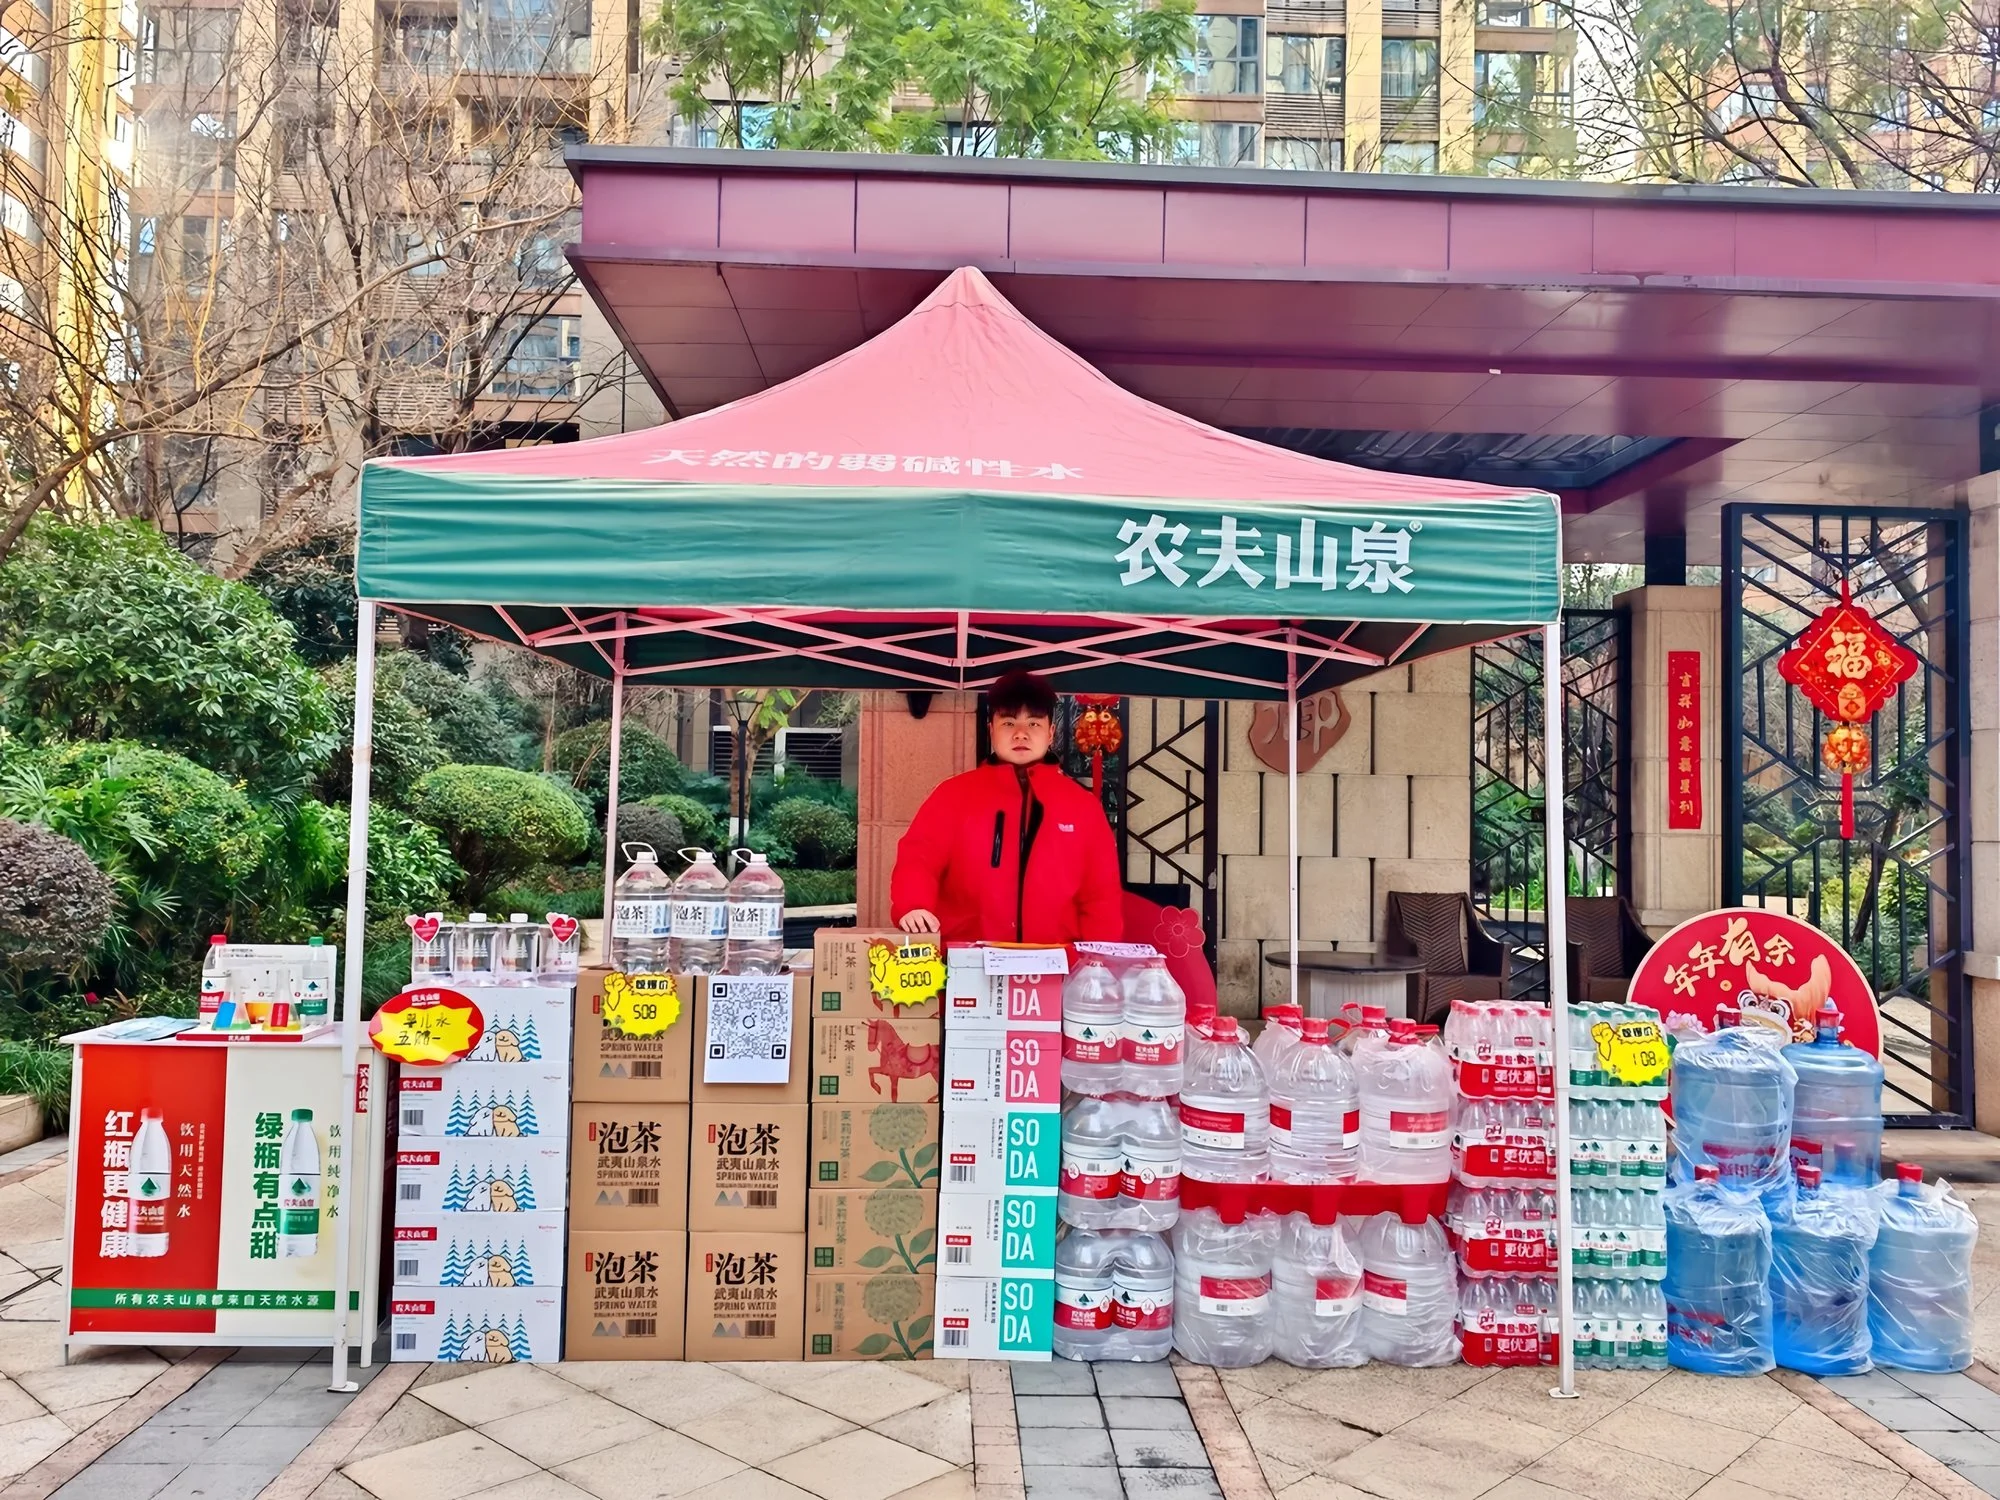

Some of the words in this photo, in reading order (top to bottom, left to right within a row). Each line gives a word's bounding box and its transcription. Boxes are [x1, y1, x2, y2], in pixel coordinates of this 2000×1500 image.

[641, 449, 1085, 480] 天然的弱碱性水
[1113, 513, 1416, 594] 农夫山泉
[1825, 631, 1872, 679] 福
[1663, 917, 1796, 997] 年年有余
[1012, 988, 1041, 1016] DA
[600, 1043, 631, 1052] SPRING
[634, 1043, 663, 1052] WATER
[1010, 1038, 1040, 1066] SO
[1010, 1069, 1040, 1098] DA
[1494, 1069, 1536, 1084] 更优惠
[598, 1121, 662, 1154] 泡茶
[717, 1123, 780, 1156] 泡茶
[1010, 1118, 1040, 1147] SO
[176, 1122, 195, 1218] 饮用天然水
[597, 1156, 661, 1169] 武夷山泉水
[716, 1157, 779, 1171] 武夷山泉水
[1010, 1150, 1039, 1179] DA
[1504, 1148, 1545, 1164] 更优惠
[99, 1109, 134, 1259] 红瓶更健康
[250, 1111, 283, 1259] 绿瓶有点甜
[326, 1123, 342, 1219] 饮用纯净水
[596, 1170, 628, 1179] SPRING
[631, 1170, 660, 1179] WATER
[716, 1172, 747, 1181] SPRING
[749, 1172, 778, 1181] WATER
[1006, 1199, 1036, 1229] SO
[1006, 1232, 1035, 1261] DA
[1504, 1242, 1544, 1258] 更优惠
[595, 1251, 659, 1285] 泡茶
[714, 1252, 778, 1286] 泡茶
[114, 1293, 320, 1307] 所有农夫山泉都来自天然水源
[594, 1286, 659, 1299] 武夷山泉水
[594, 1301, 625, 1310] SPRING
[628, 1300, 657, 1309] WATER
[713, 1302, 745, 1311] SPRING
[747, 1302, 777, 1311] WATER
[714, 1287, 777, 1301] 武夷山泉水
[1004, 1282, 1034, 1311] SO
[1003, 1314, 1033, 1344] DA
[1496, 1337, 1537, 1352] 更优惠
